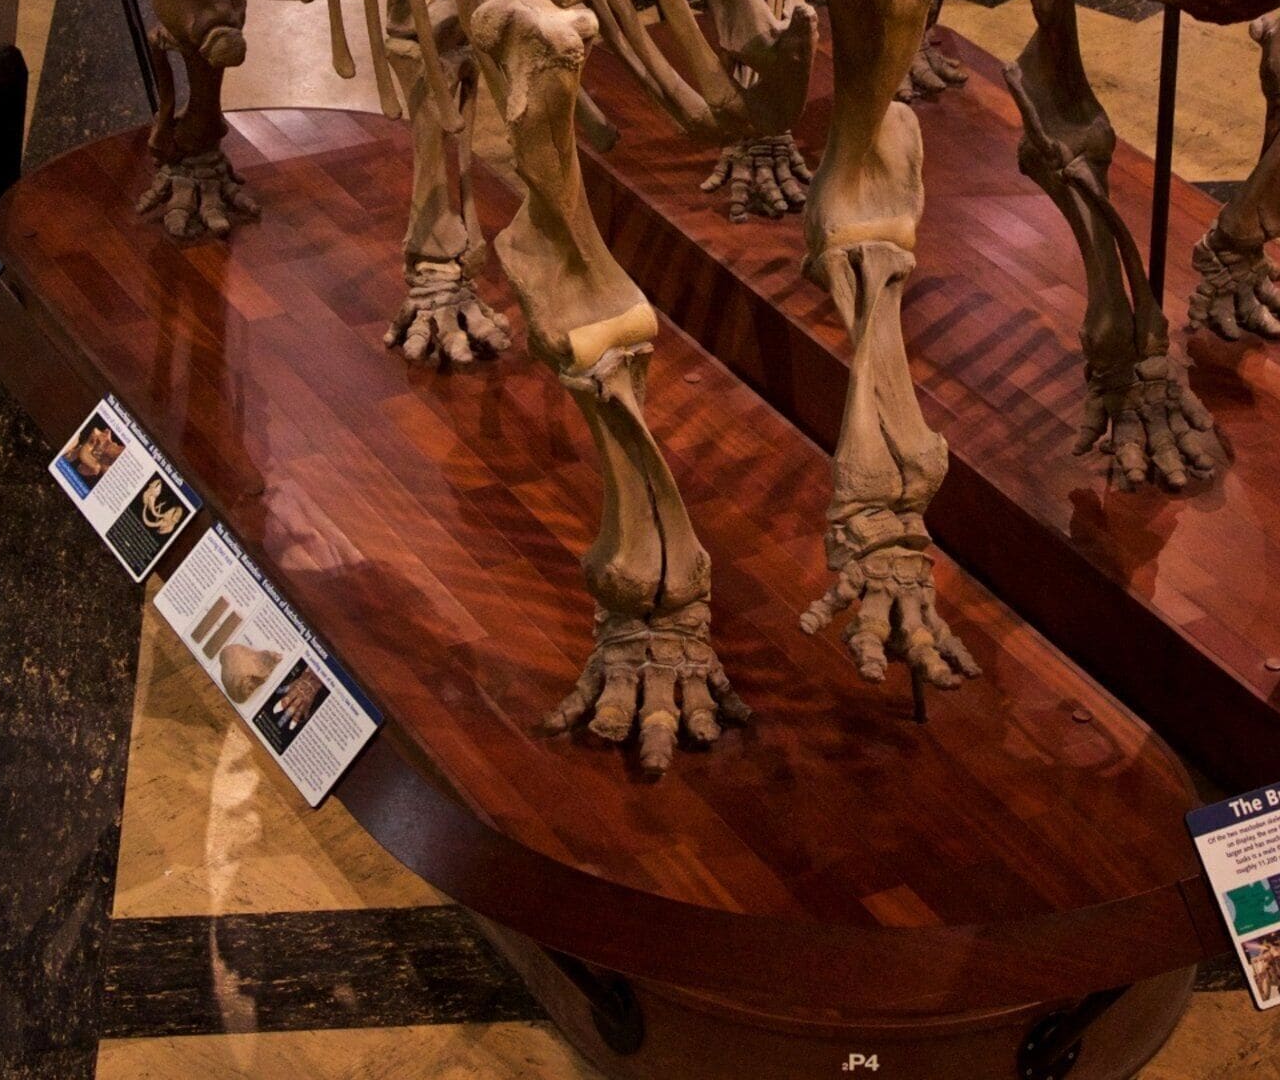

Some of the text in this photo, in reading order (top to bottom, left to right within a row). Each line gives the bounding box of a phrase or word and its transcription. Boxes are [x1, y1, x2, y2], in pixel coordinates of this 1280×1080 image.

[214, 522, 225, 535] The
[261, 578, 281, 603] Evidence
[278, 598, 287, 609] of
[282, 604, 307, 635] butchering
[302, 629, 313, 642] by
[309, 636, 329, 660] humans
[1229, 796, 1263, 818] The
